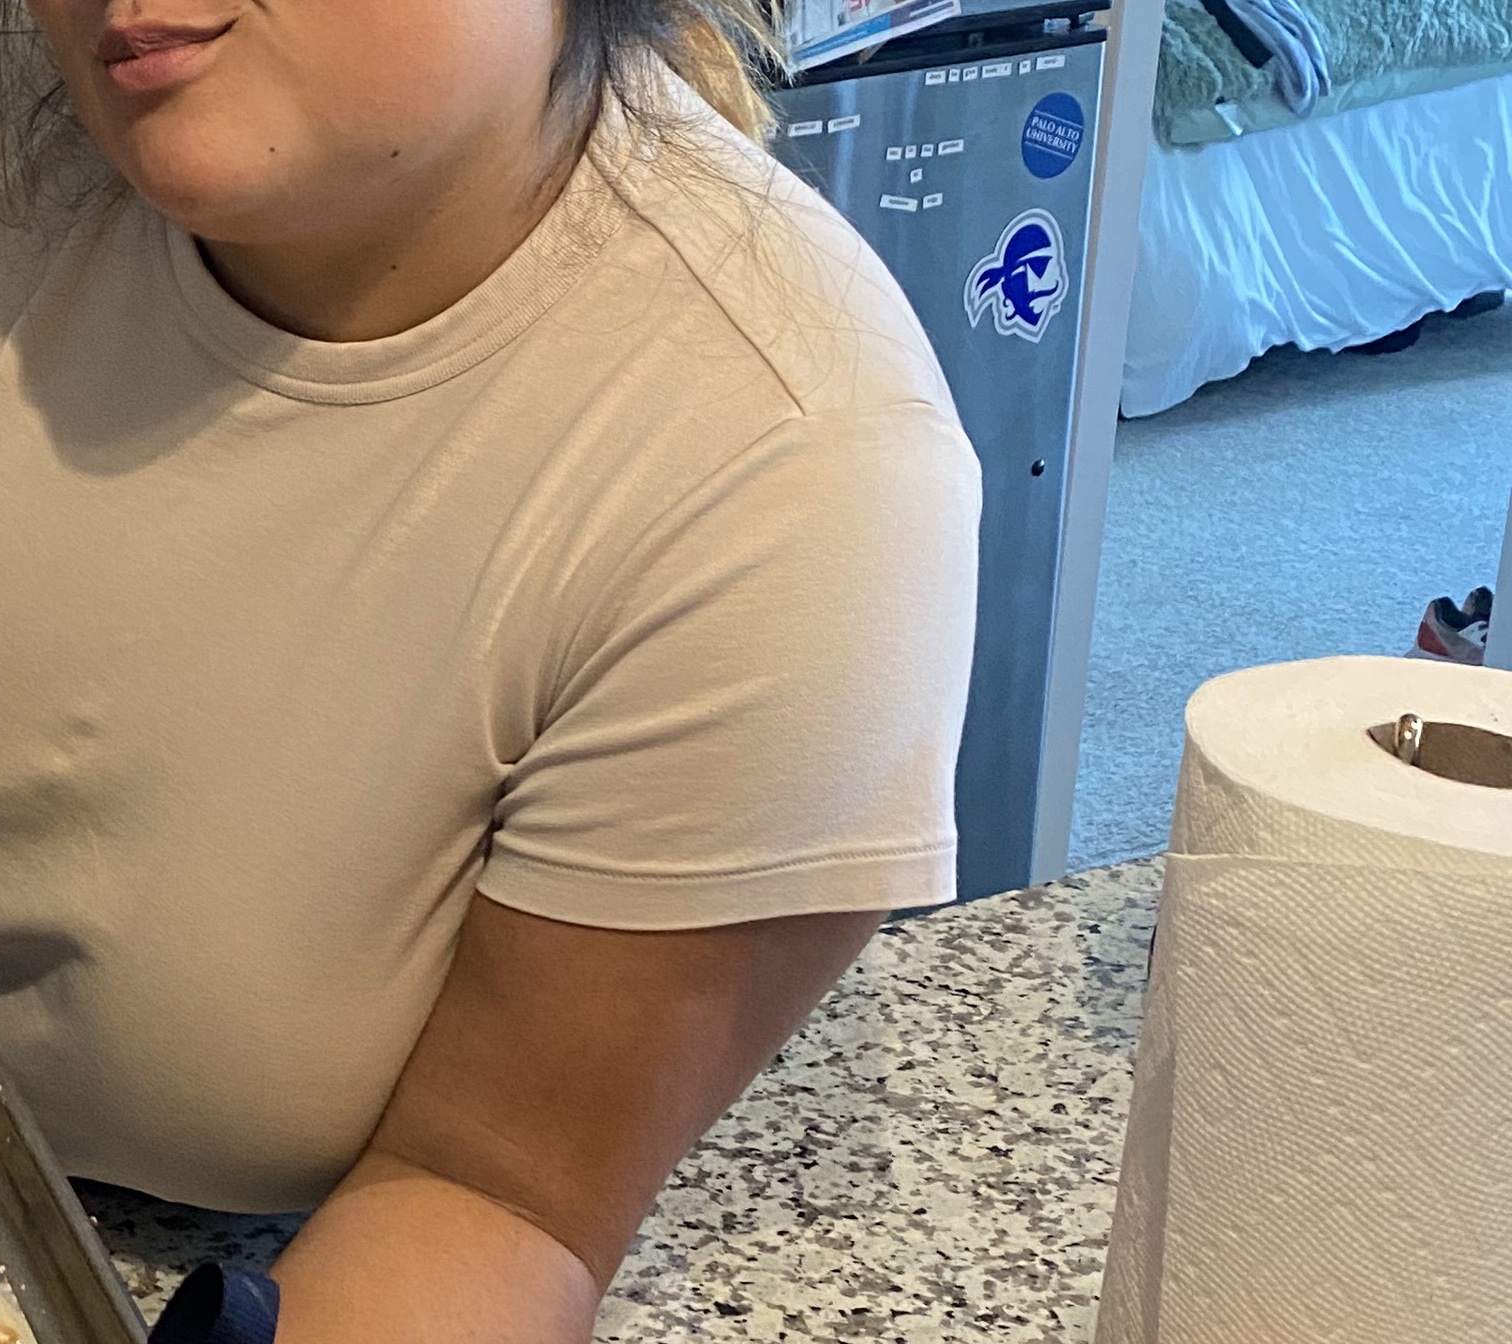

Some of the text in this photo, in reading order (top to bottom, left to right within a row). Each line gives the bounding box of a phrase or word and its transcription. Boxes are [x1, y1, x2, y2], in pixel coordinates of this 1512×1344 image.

[1026, 127, 1079, 153] UNIVERSITY
[1031, 116, 1080, 141] PALO ALTO
